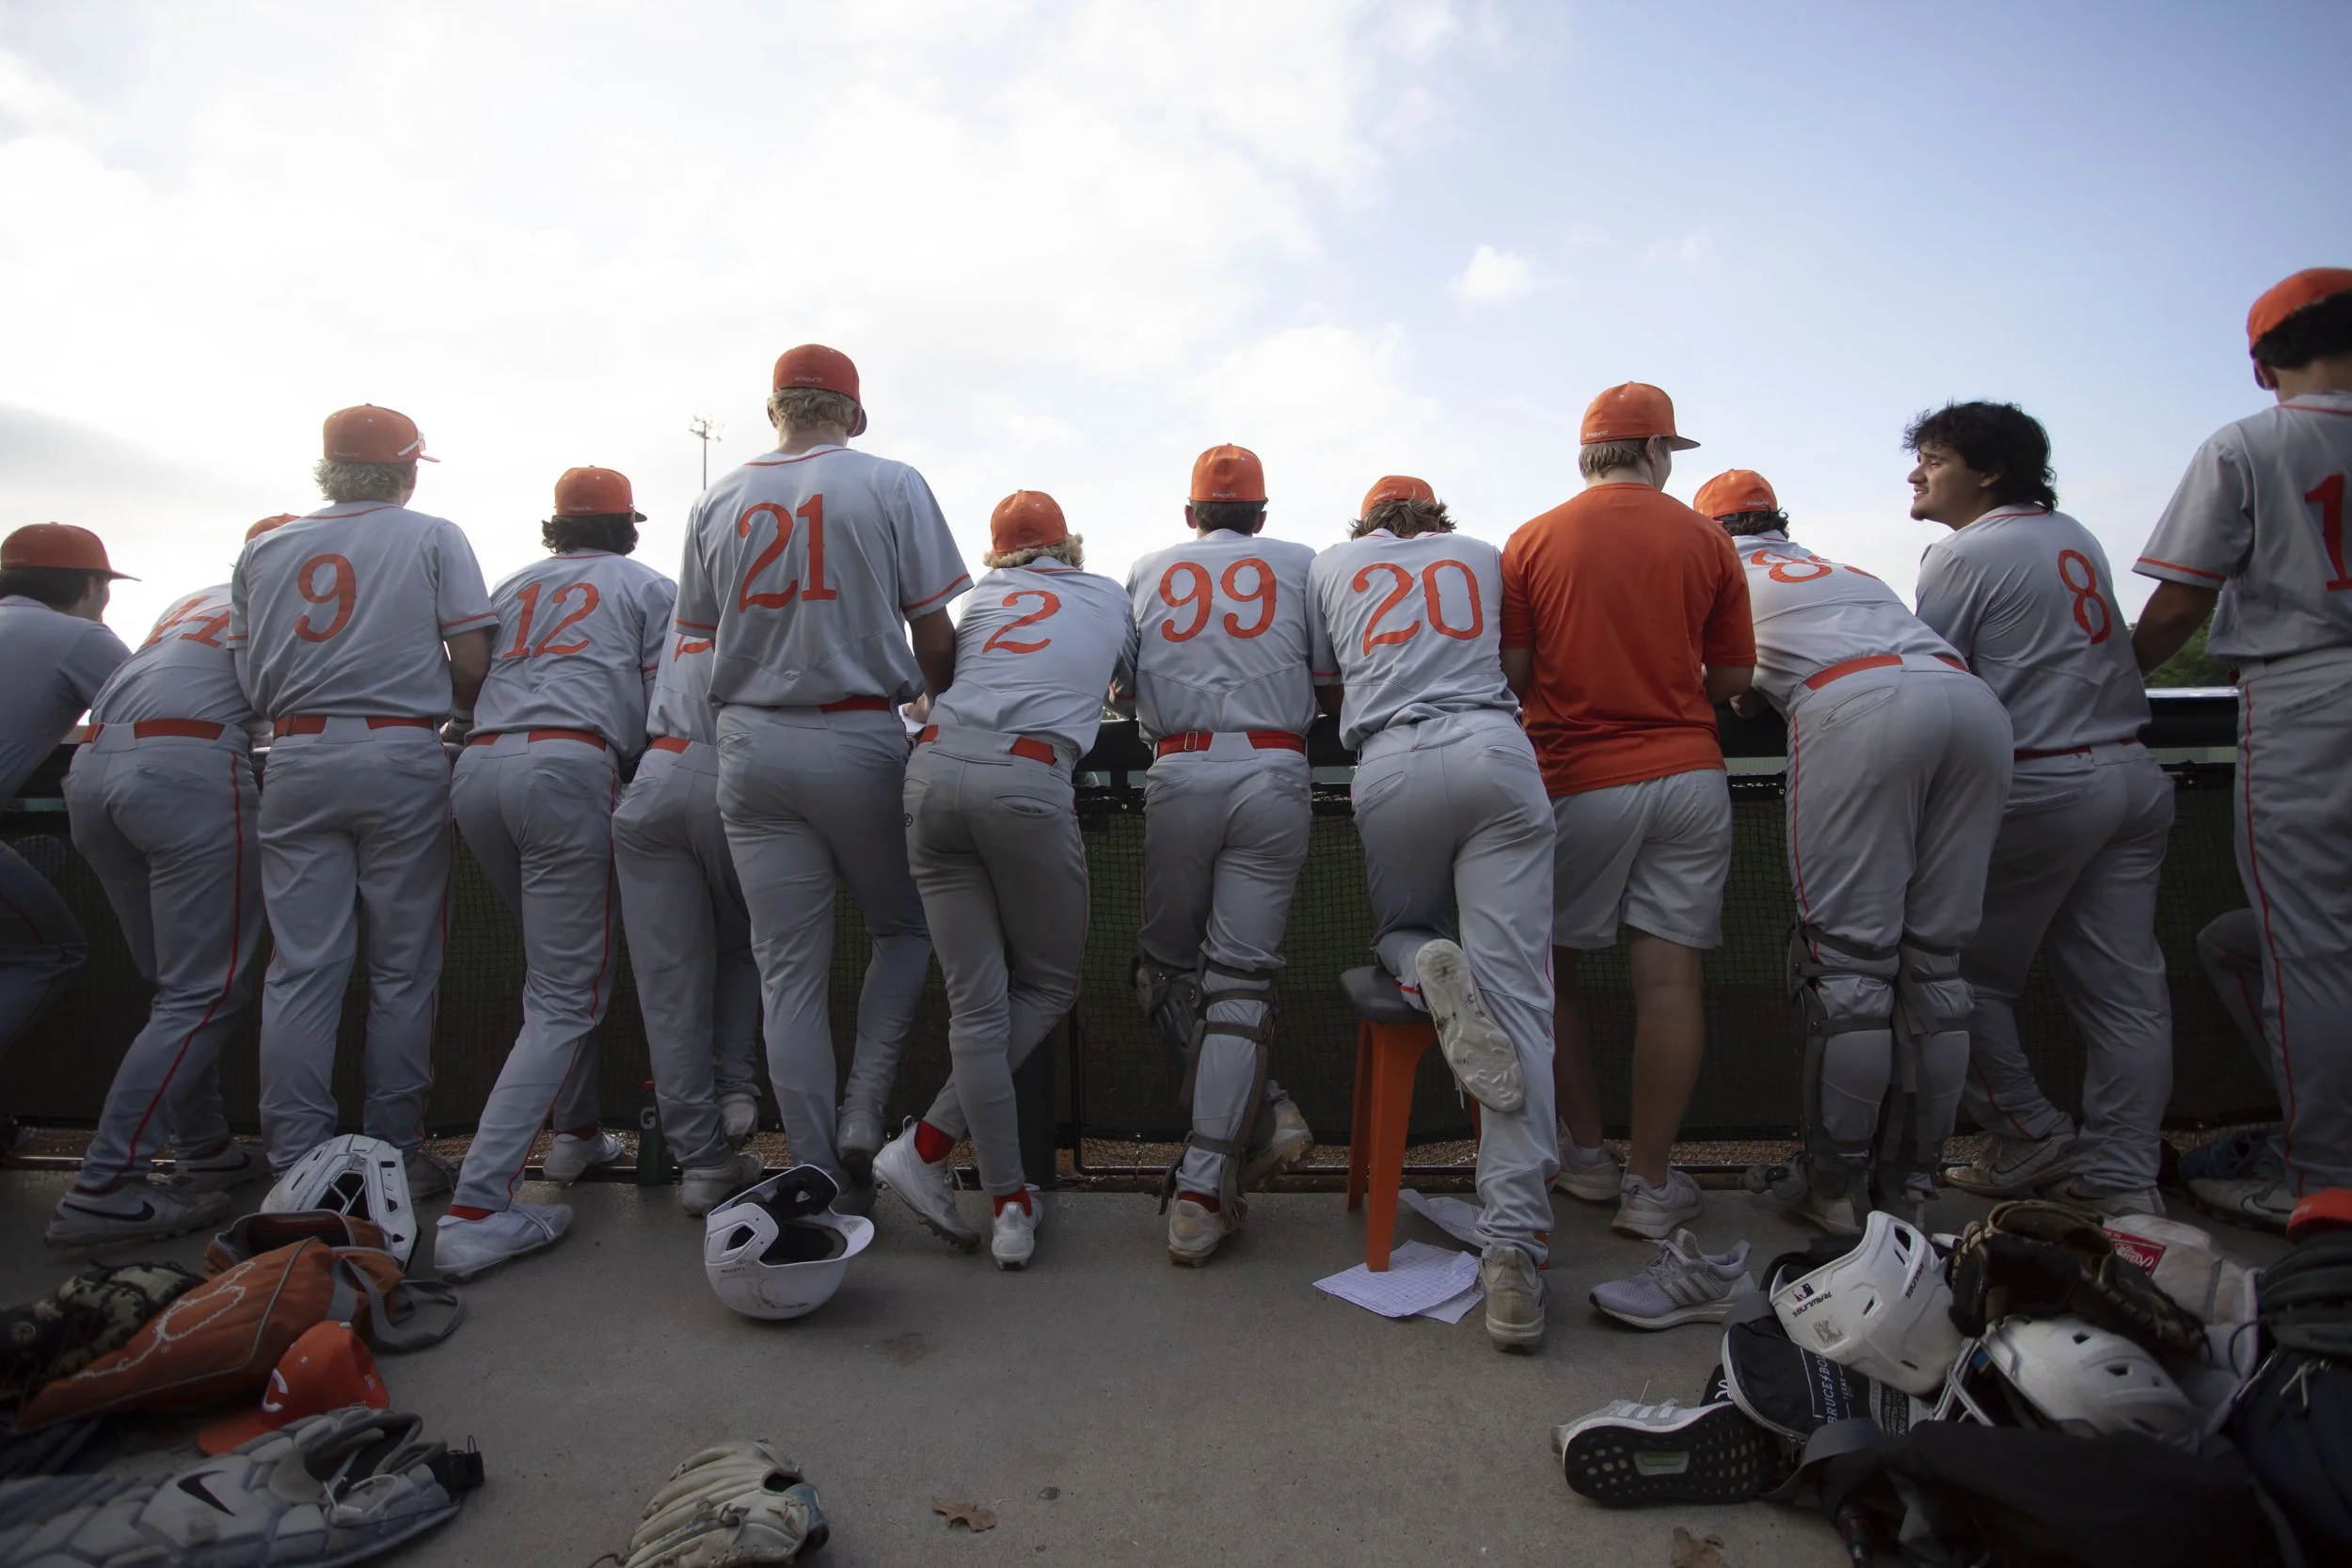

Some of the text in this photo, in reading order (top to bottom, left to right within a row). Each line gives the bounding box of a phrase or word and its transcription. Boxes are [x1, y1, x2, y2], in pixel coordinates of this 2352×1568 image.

[738, 494, 836, 613] 21
[2306, 473, 2352, 593] 1
[294, 553, 357, 642] 9
[501, 582, 600, 659] 12
[982, 590, 1061, 654] 2
[1159, 558, 1277, 642] 99
[1352, 560, 1484, 657] 20
[2058, 548, 2112, 644] 8
[1791, 1290, 1833, 1318] RAWLINGS
